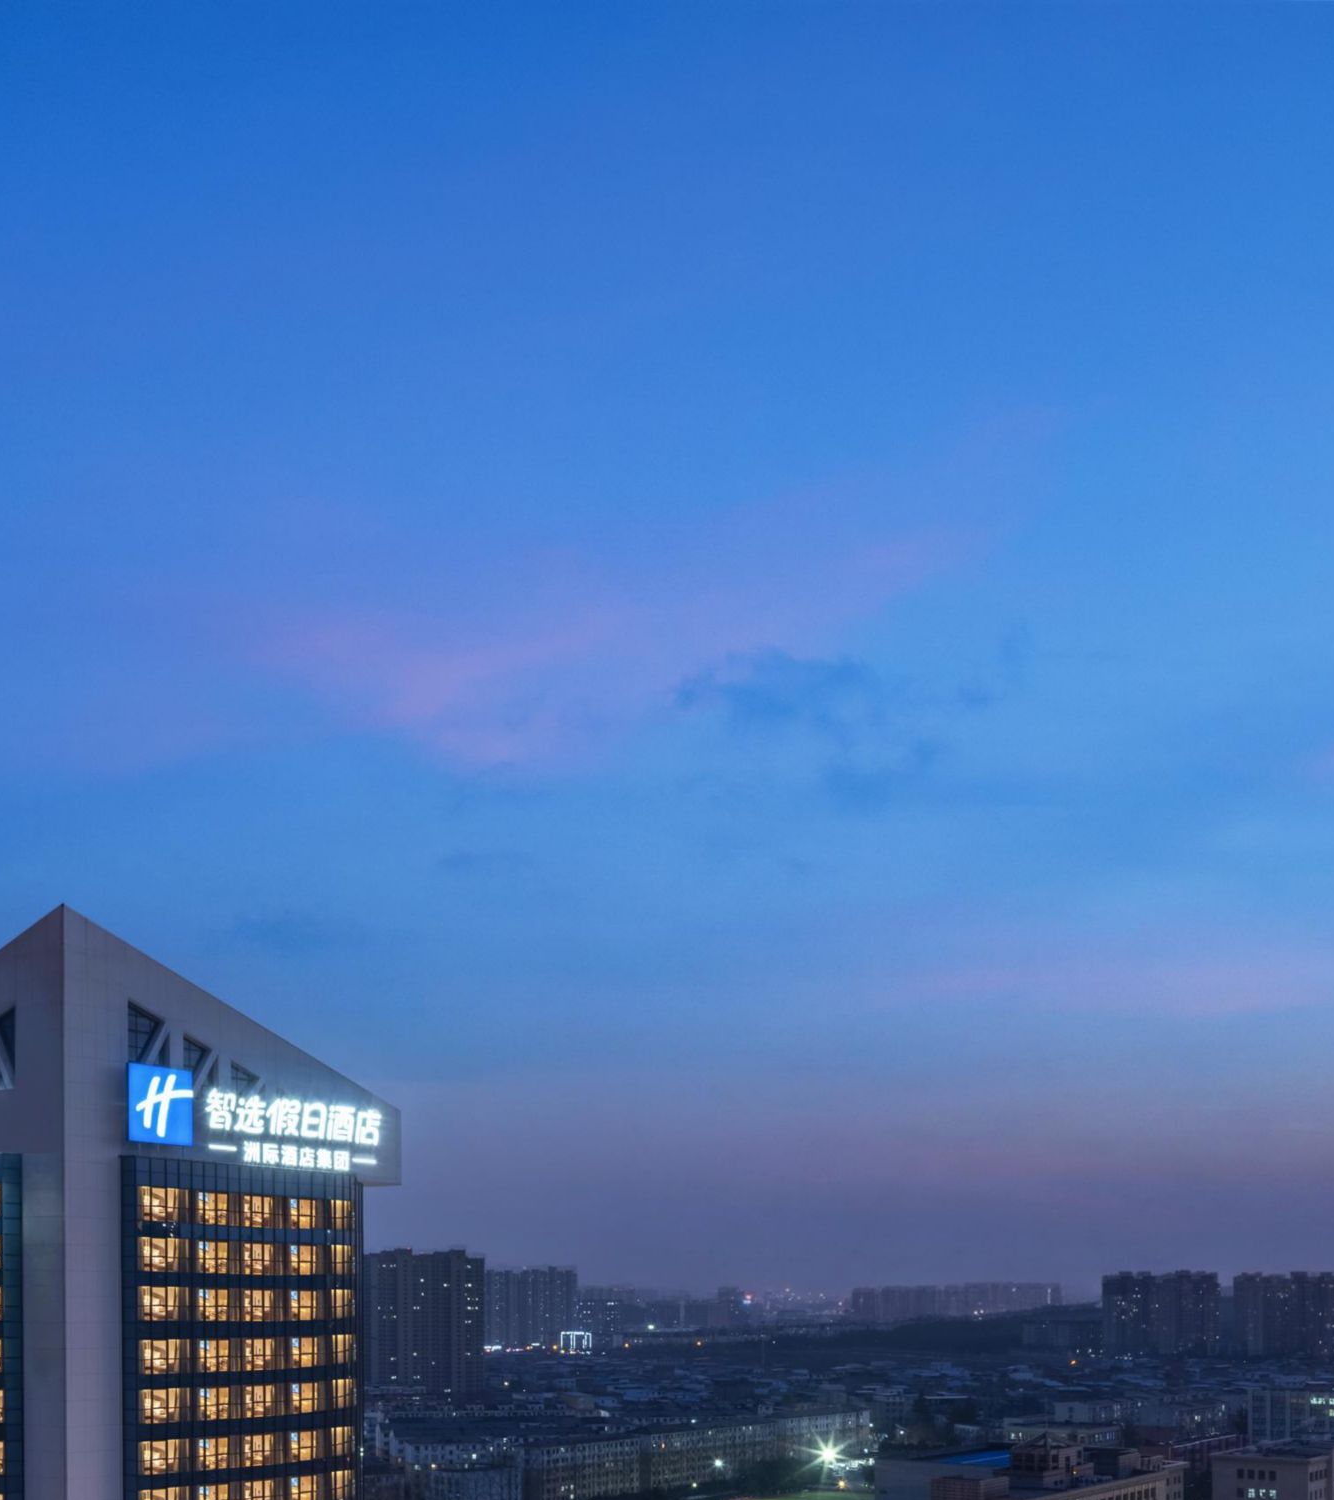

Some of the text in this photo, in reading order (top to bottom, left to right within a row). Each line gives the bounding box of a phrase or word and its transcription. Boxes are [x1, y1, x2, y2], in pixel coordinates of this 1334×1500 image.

[205, 1087, 383, 1146] 智选假日酒店
[243, 1141, 351, 1171] 洲际酒店集团
